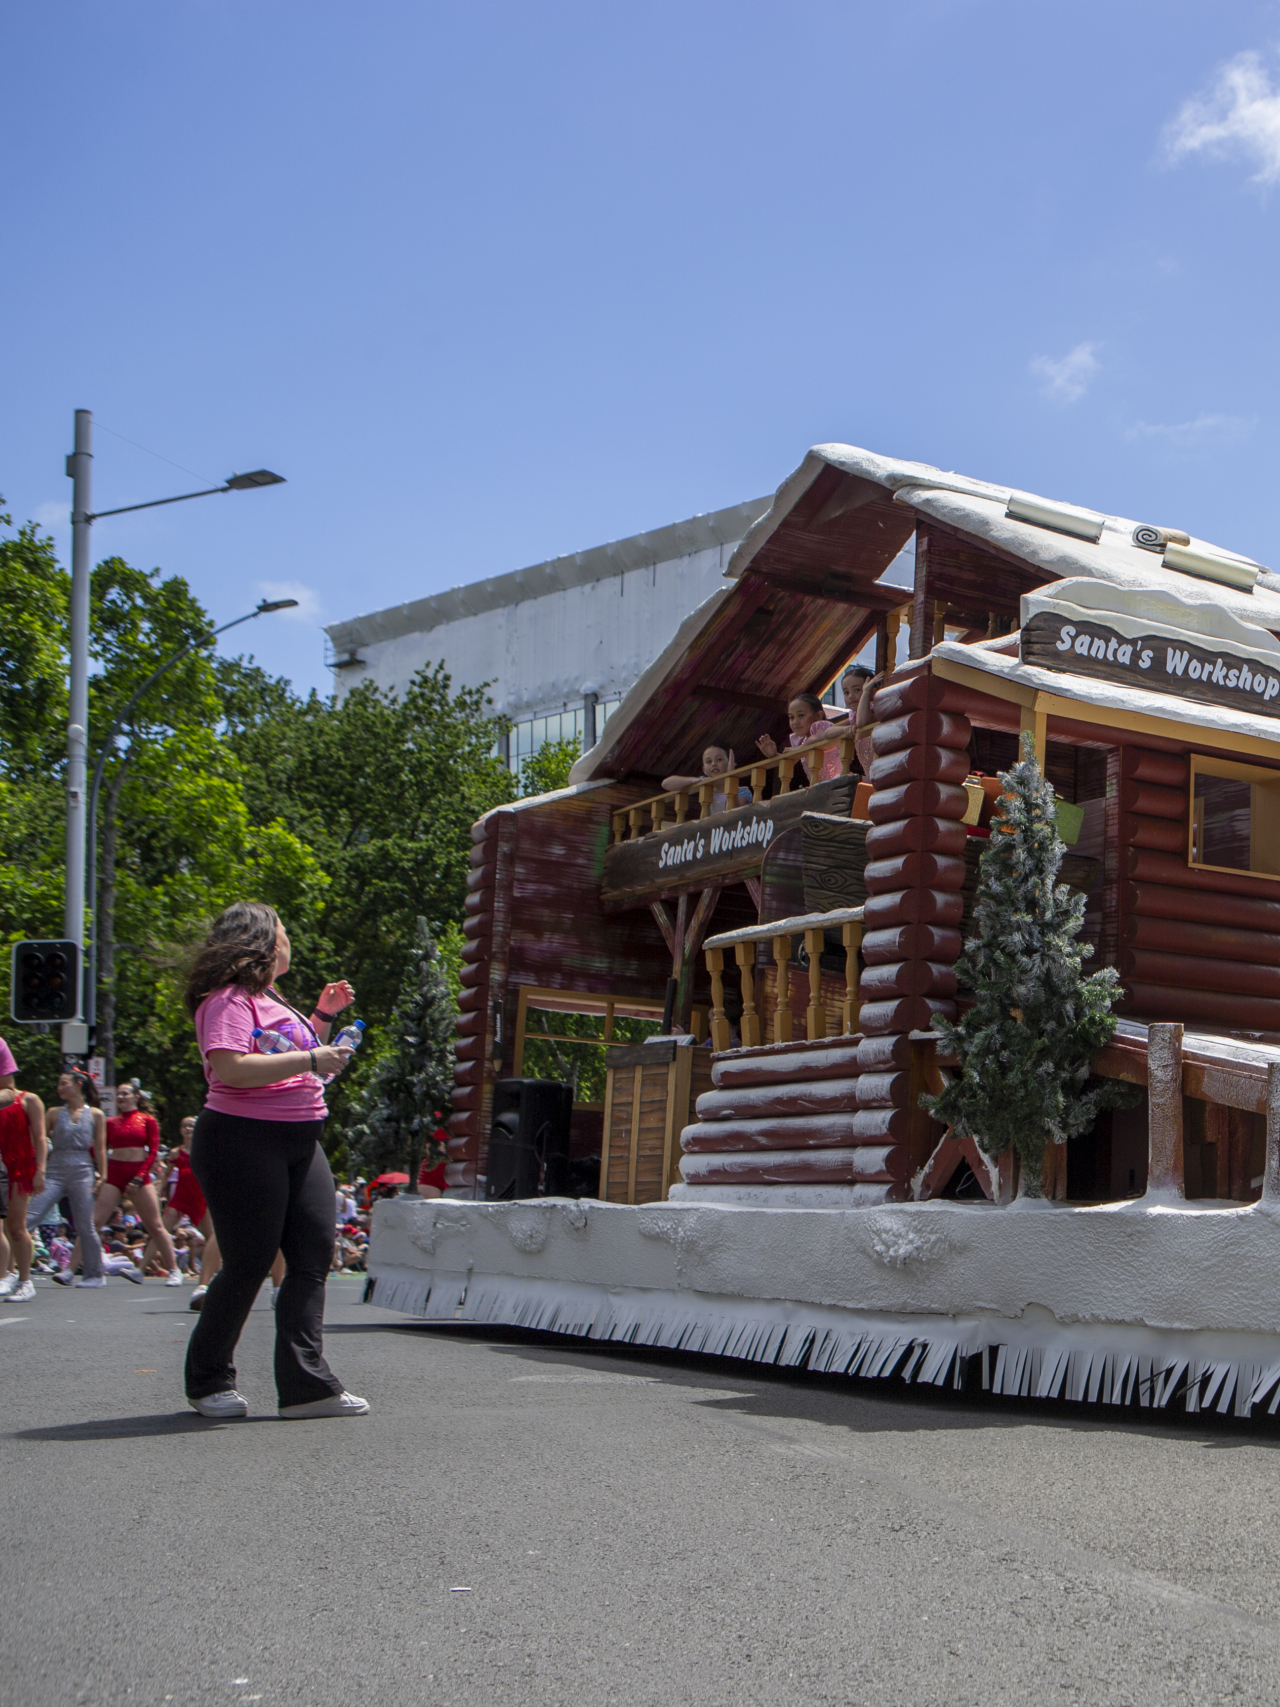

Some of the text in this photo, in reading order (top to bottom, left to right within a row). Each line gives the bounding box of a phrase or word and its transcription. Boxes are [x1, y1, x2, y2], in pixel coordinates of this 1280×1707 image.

[1056, 625, 1280, 700] Santa's Workshop
[659, 815, 774, 868] Santa's Workshop
